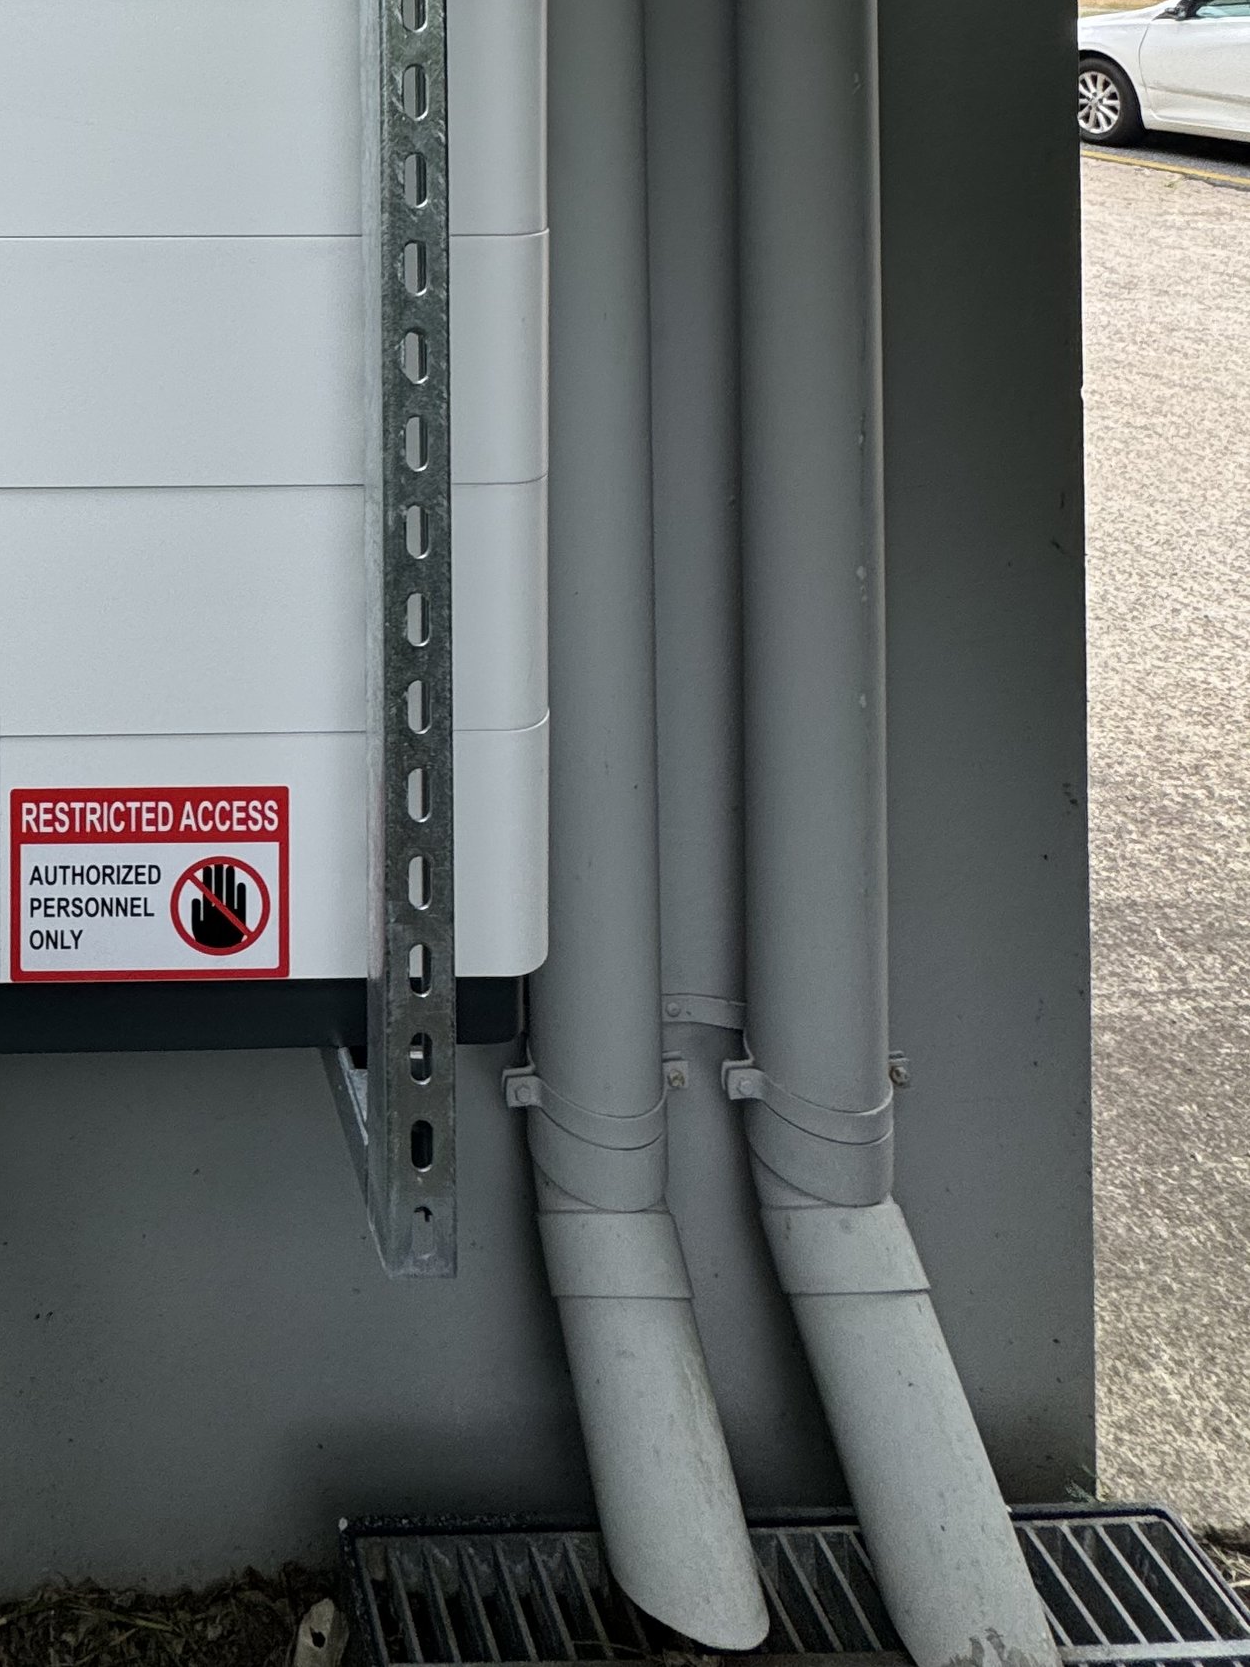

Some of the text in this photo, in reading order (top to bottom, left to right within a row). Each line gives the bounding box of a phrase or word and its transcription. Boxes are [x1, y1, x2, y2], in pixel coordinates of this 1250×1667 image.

[21, 800, 279, 833] RESTRICTED ACCESS
[29, 864, 162, 886] AUTHORIZED
[29, 896, 155, 918] PERSONNEL
[29, 929, 84, 951] ONLY
